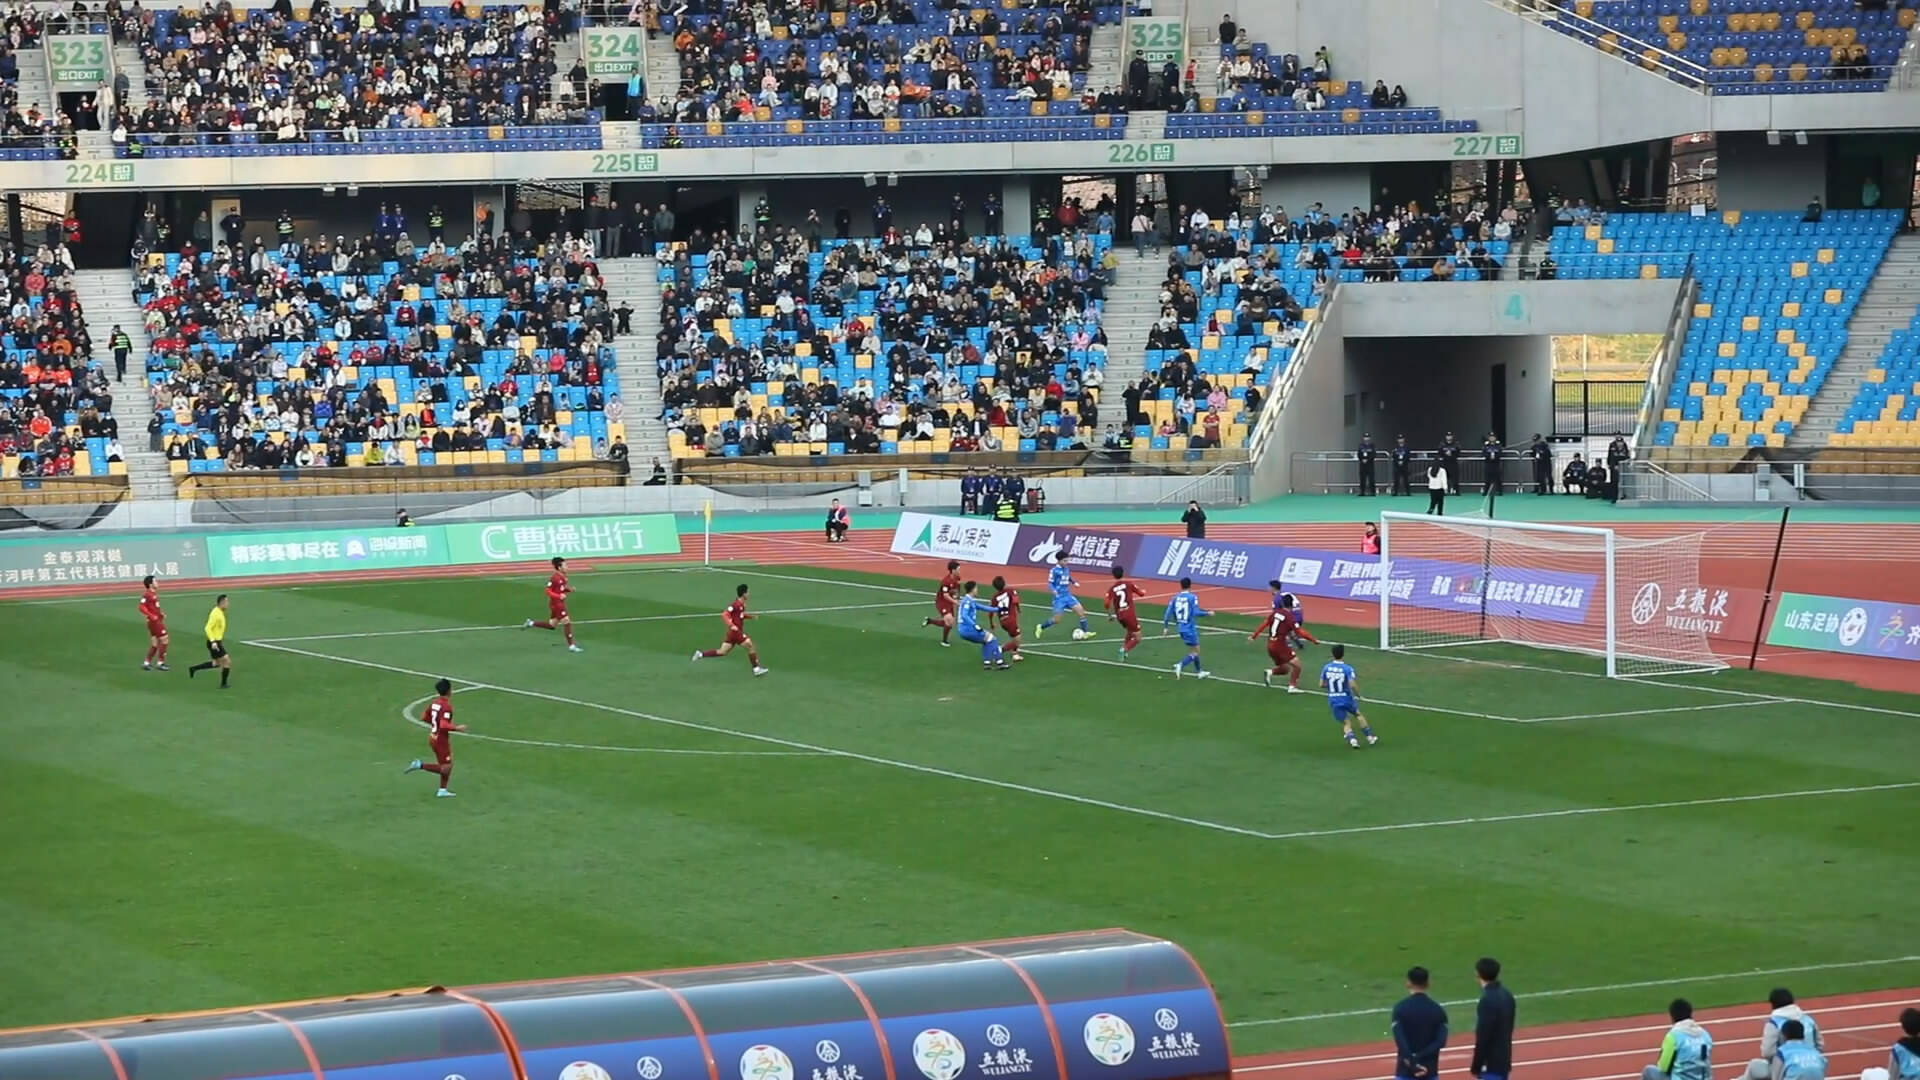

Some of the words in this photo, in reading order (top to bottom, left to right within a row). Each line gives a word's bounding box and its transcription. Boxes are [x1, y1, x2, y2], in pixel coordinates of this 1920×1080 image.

[1131, 24, 1181, 46] 325
[52, 41, 103, 65] 323
[588, 34, 639, 57] 324
[1109, 144, 1148, 162] 226
[1454, 136, 1492, 155] 227
[66, 163, 107, 182] 224
[592, 154, 631, 172] 225
[1504, 295, 1523, 319] 4
[512, 521, 644, 555] 曹操出行
[230, 541, 341, 563] 精彩赛事尽在
[0, 562, 179, 583] 河畔第五代科技健康人居
[1187, 546, 1249, 579] 华能售电
[1116, 590, 1128, 608] 2
[1175, 601, 1189, 620] 21
[1784, 609, 1840, 633] 山东足协
[1326, 672, 1345, 692] 77
[1151, 1048, 1200, 1060] WULIANGYE
[981, 1063, 1032, 1076] WULIANGYE
